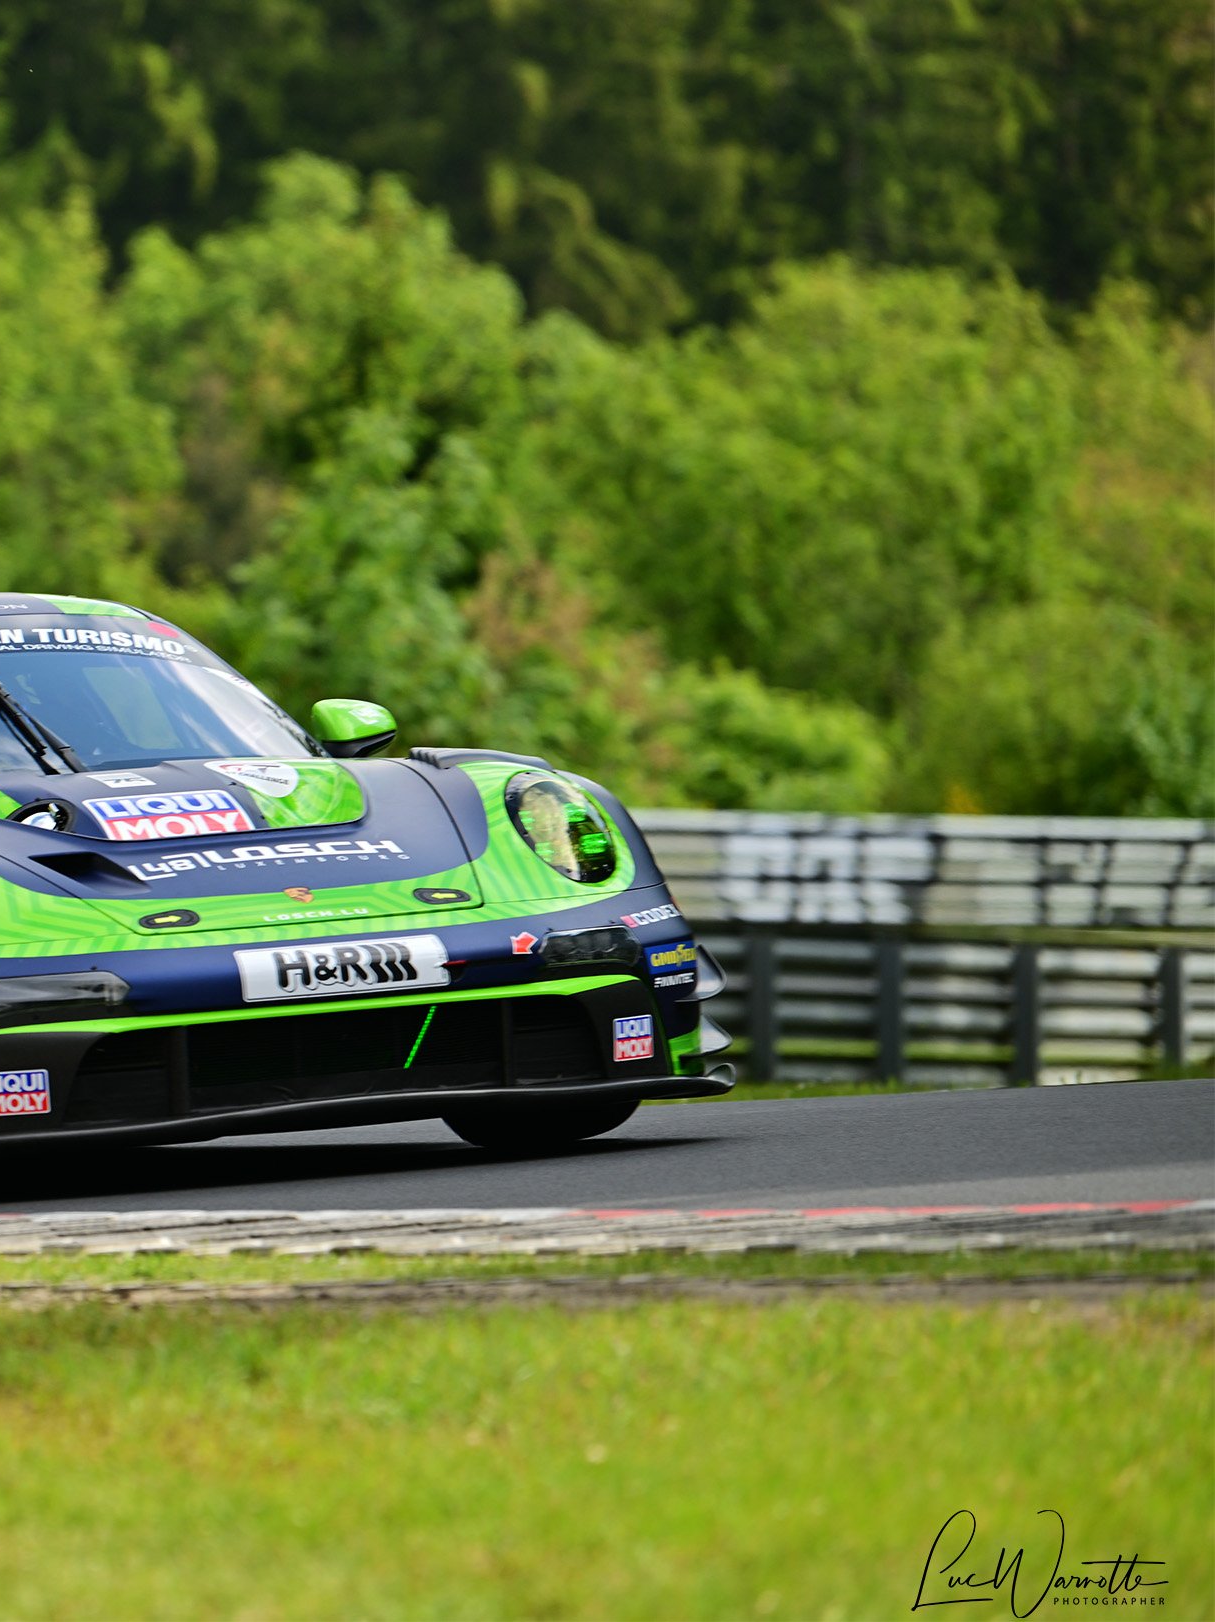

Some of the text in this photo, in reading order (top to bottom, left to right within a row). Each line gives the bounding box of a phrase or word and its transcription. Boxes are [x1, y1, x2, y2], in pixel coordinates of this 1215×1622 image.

[32, 628, 186, 655] TURISMO
[95, 792, 231, 819] LIQUI
[111, 811, 244, 840] MOLY
[202, 840, 404, 864] LOSCH
[216, 853, 411, 871] LUXEMBOURG
[263, 906, 370, 923] LOSCH.LU
[274, 944, 373, 991] H&R
[616, 1018, 652, 1039] LIQUI
[616, 1037, 652, 1058] MOLY
